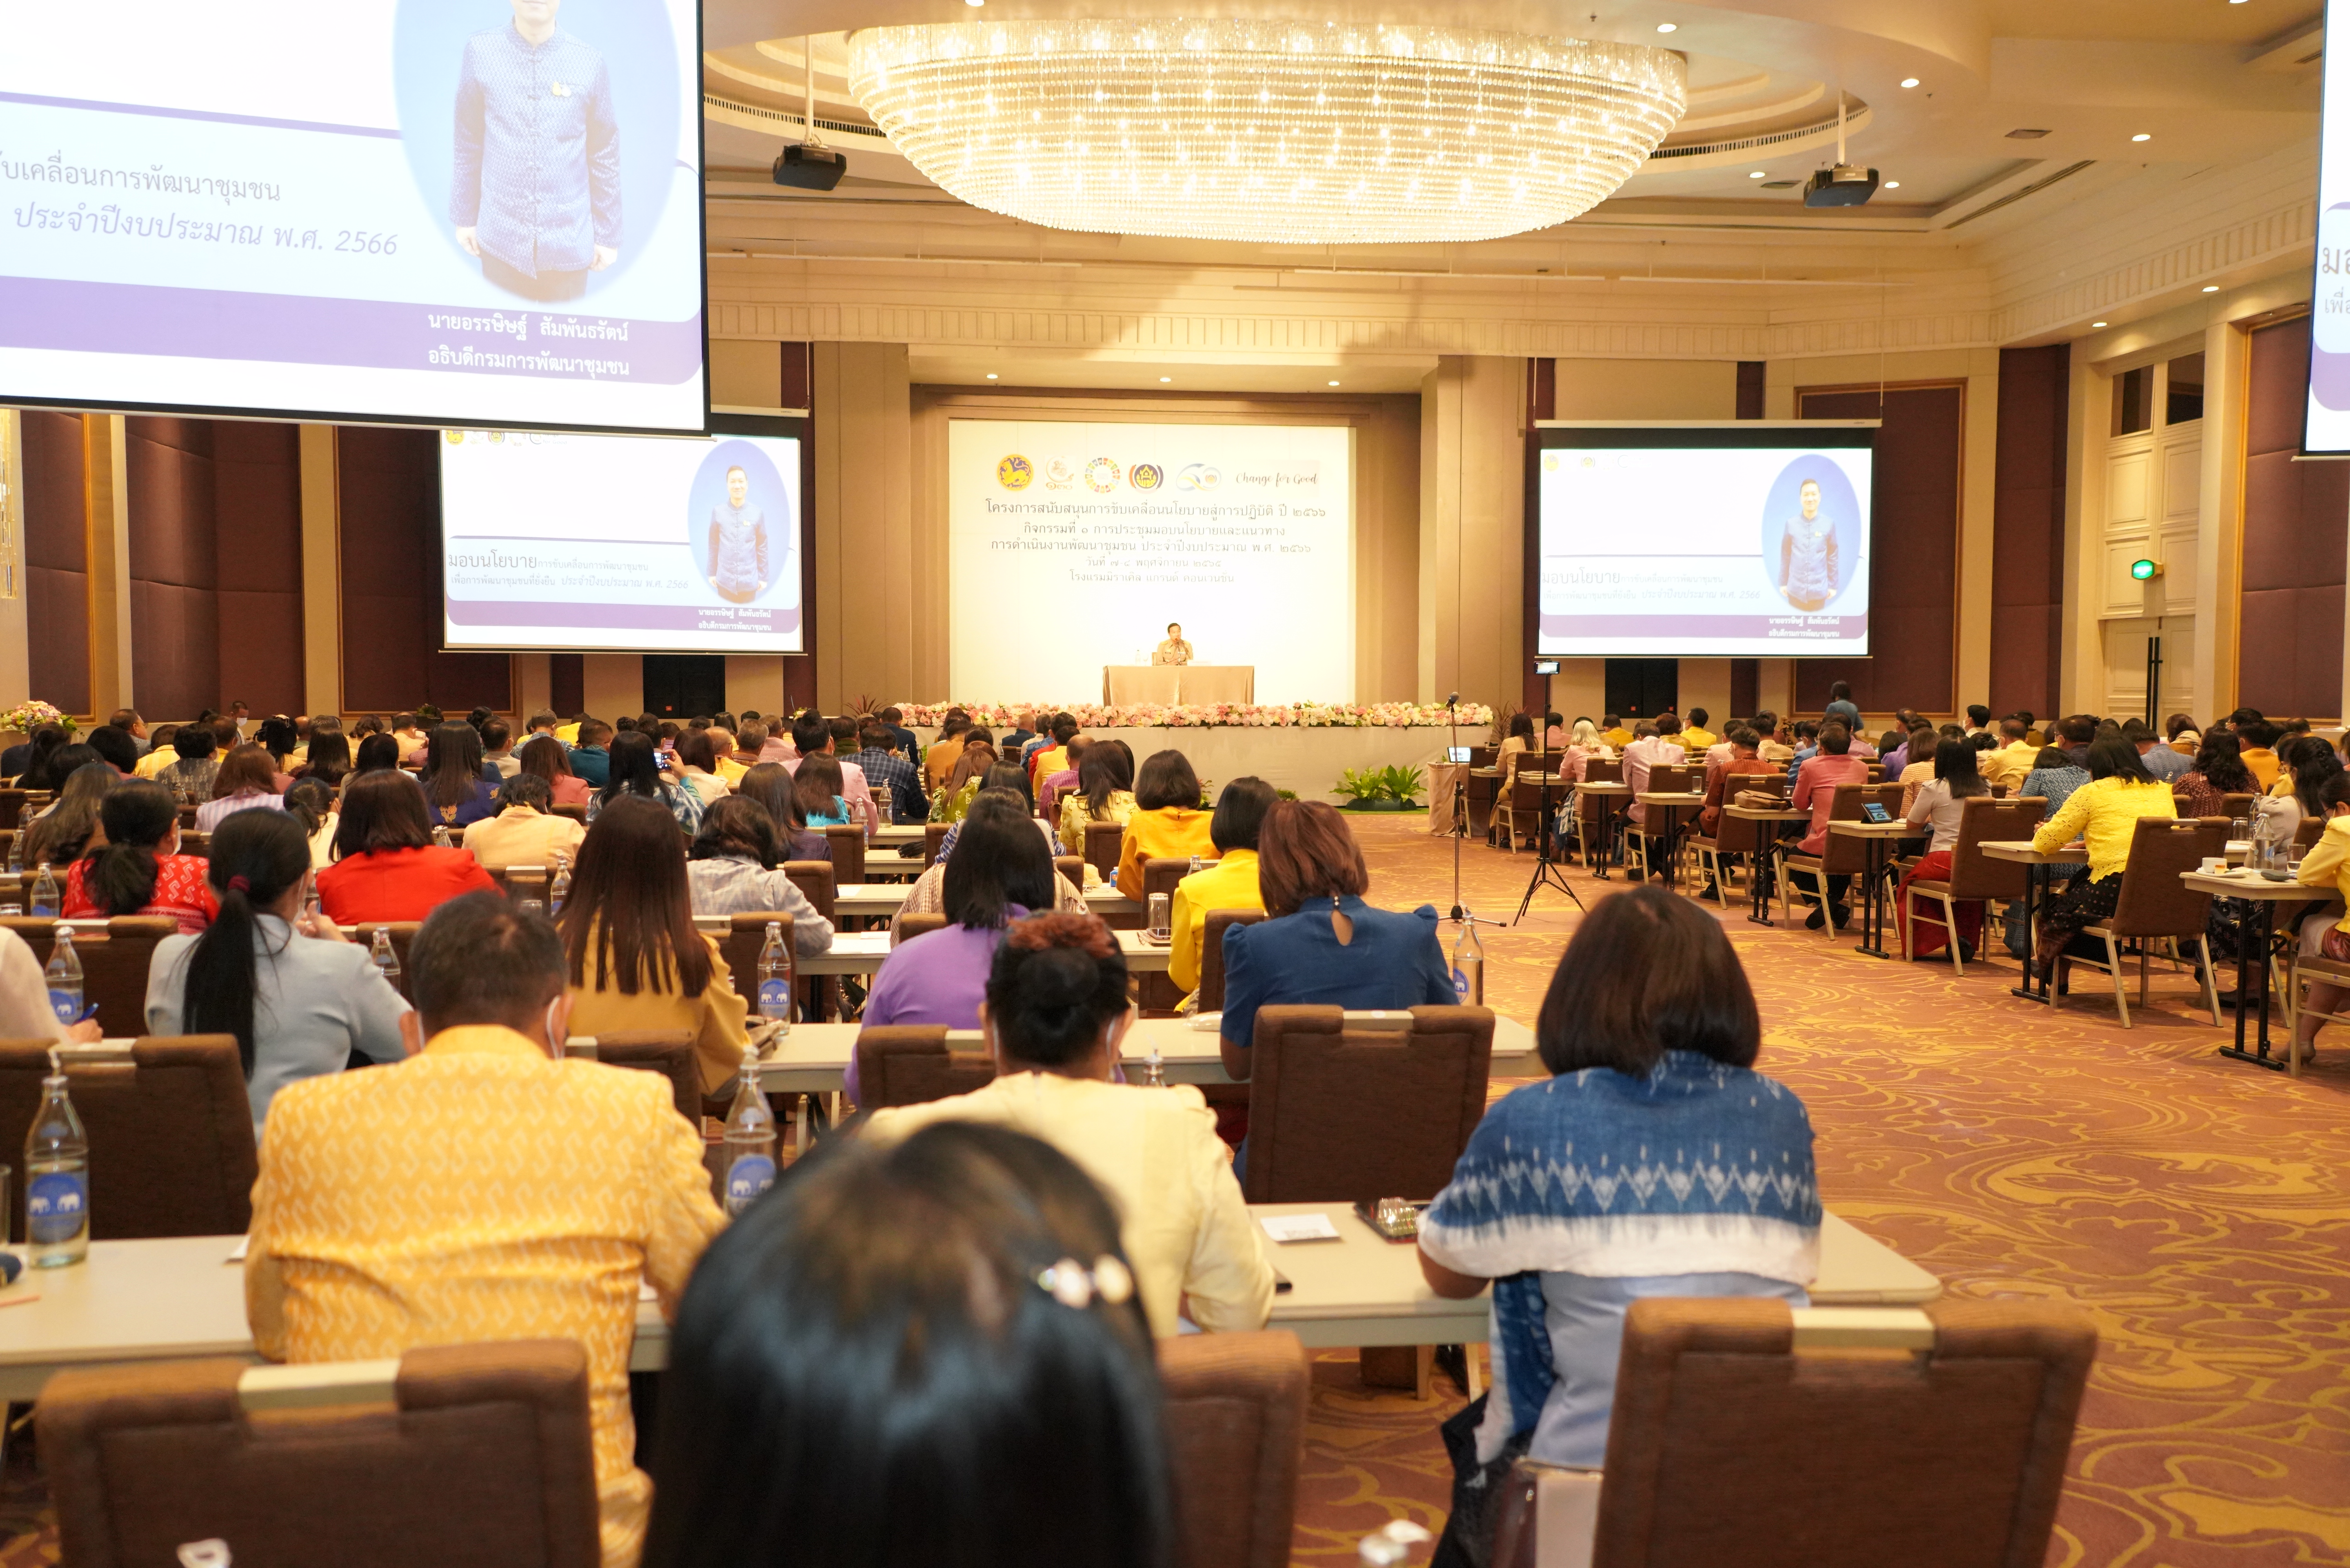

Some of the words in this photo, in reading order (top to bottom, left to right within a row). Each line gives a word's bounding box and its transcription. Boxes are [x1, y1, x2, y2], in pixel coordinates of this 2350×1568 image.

[0, 150, 280, 206] บเคลื่อนการพัฒนาชุมชน
[15, 201, 263, 245] ประจำปีงบประมาณ
[274, 227, 322, 250] พ.ศ.
[335, 230, 398, 255] 2566
[540, 316, 628, 342] สัมพันธรัตน์
[428, 344, 629, 379] อธิบดีกรมการพัฒนาชุมชน
[1236, 472, 1274, 486] Change
[1276, 472, 1290, 487] for
[1294, 473, 1318, 484] Good
[985, 498, 1273, 521] โครงการสนับสนุนการขับเคลื่อนนโยบายสู่การปฏิบัติ
[1279, 503, 1287, 517] ปี
[1293, 508, 1326, 517] ๒๕๖๖
[1024, 519, 1076, 534] กิจกรรมที่
[1094, 521, 1285, 539] การประชุมมอบนโยบายและแนวทาง
[991, 537, 1136, 555] การดำเนินงานพัฒนาชุมชน
[1141, 539, 1247, 553] ประจำปีงบประมาณ
[1251, 543, 1275, 553] พ.ศ.
[1280, 544, 1311, 553] ๒๕๖๖
[448, 549, 537, 568] มอบนโยบาย
[1085, 554, 1105, 567] วันที่
[1136, 557, 1189, 569] พฤศจิกายน
[561, 574, 643, 588] ประจำปีงบประมาณ
[666, 580, 689, 589] 2566
[1070, 568, 1141, 582] โรงแรมมิราเคิล
[1146, 571, 1179, 583] แกรนด์
[1739, 591, 1761, 599] 2566
